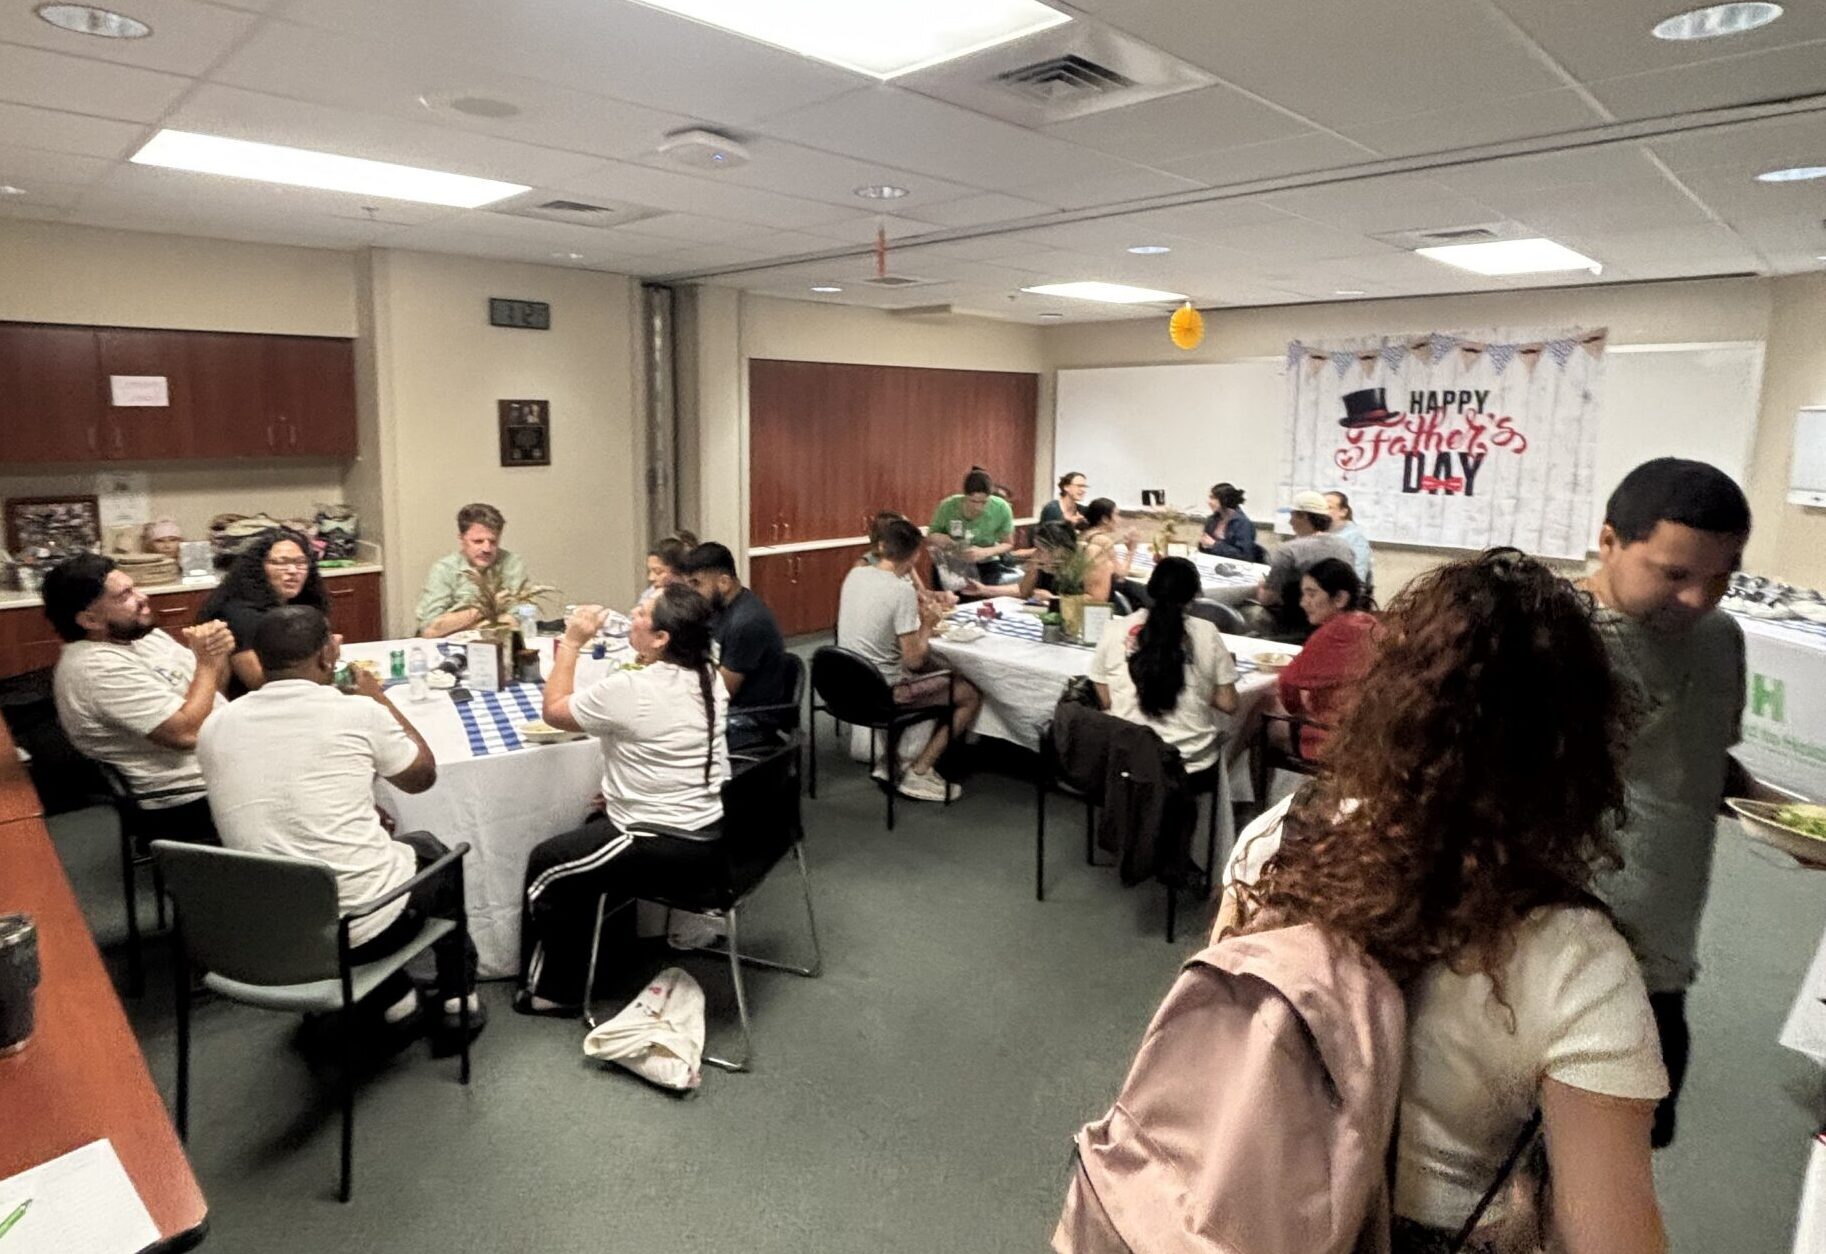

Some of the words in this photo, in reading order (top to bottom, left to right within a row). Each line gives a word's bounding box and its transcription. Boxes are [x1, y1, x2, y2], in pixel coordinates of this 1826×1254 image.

[1410, 389, 1490, 415] HAPPY
[1334, 405, 1528, 472] Father's
[1402, 451, 1486, 496] DAY
